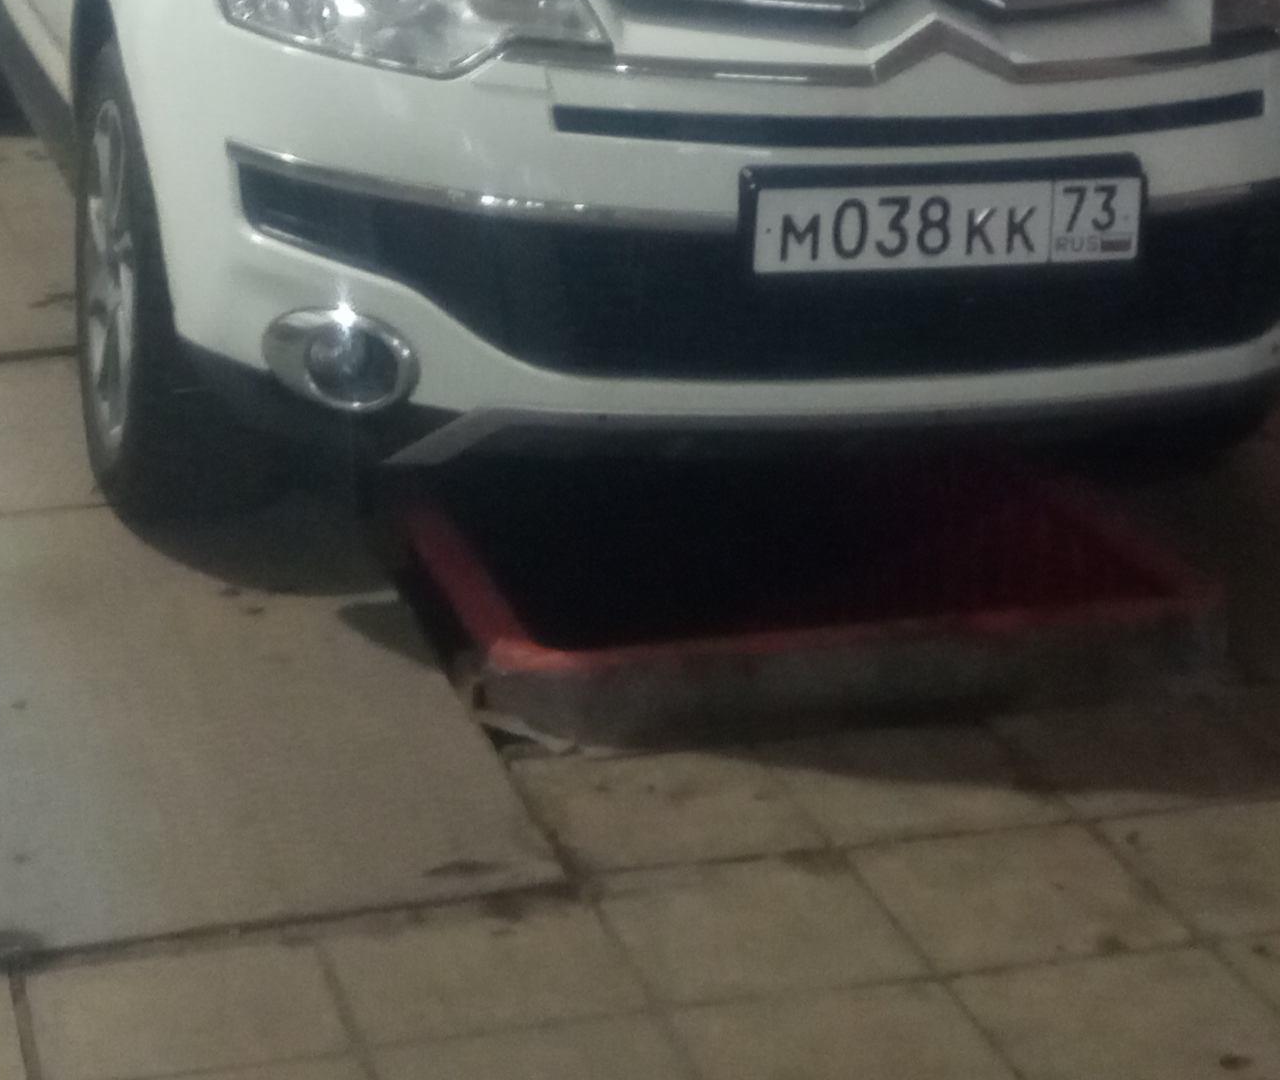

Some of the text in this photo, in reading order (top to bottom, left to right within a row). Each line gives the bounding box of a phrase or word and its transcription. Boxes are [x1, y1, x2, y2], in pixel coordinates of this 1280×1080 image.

[779, 185, 1118, 262] М038КК 73
[1055, 234, 1099, 254] RUS
